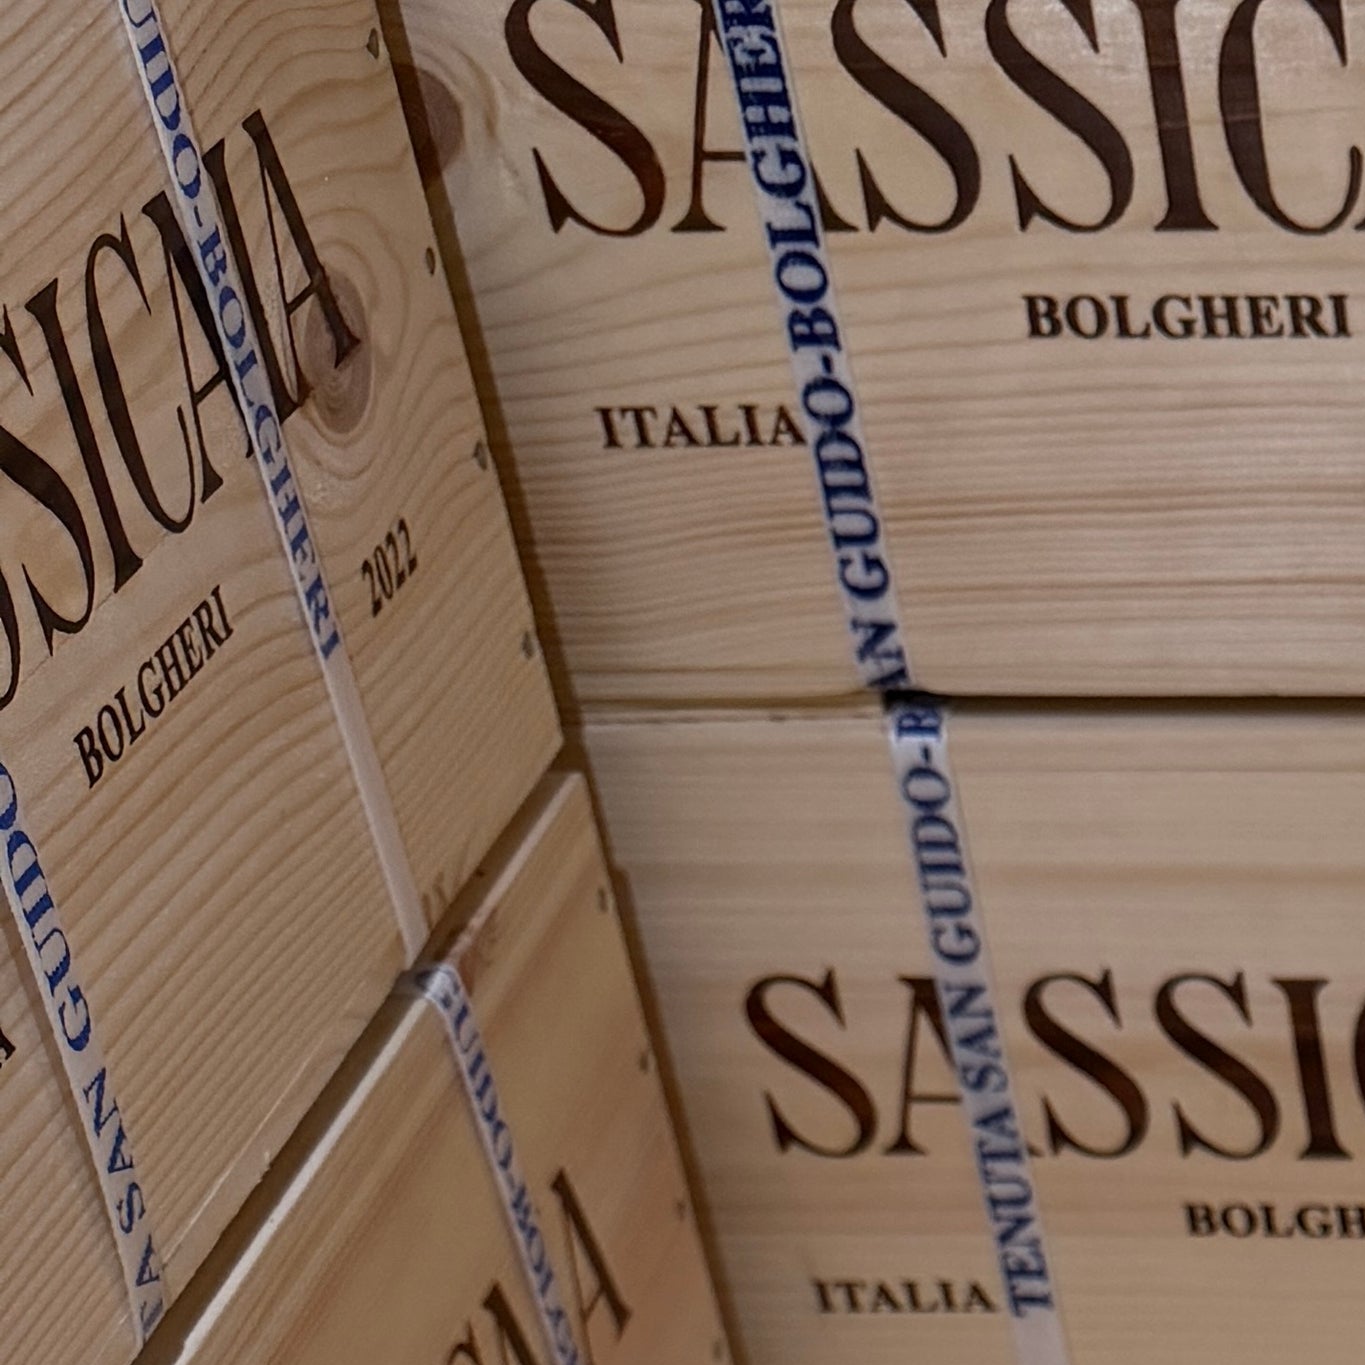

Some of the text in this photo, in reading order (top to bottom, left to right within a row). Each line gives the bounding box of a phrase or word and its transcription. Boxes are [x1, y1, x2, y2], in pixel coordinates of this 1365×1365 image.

[1024, 294, 1353, 341] BOLGHERI
[594, 404, 807, 449] ITALIA
[361, 518, 418, 618] 2022
[73, 584, 234, 790] BOLGHERI
[940, 980, 1009, 1095] SAN
[83, 1067, 146, 1235] SAN
[972, 1106, 1056, 1319] TENUTA
[811, 1278, 997, 1314] ITALIA
